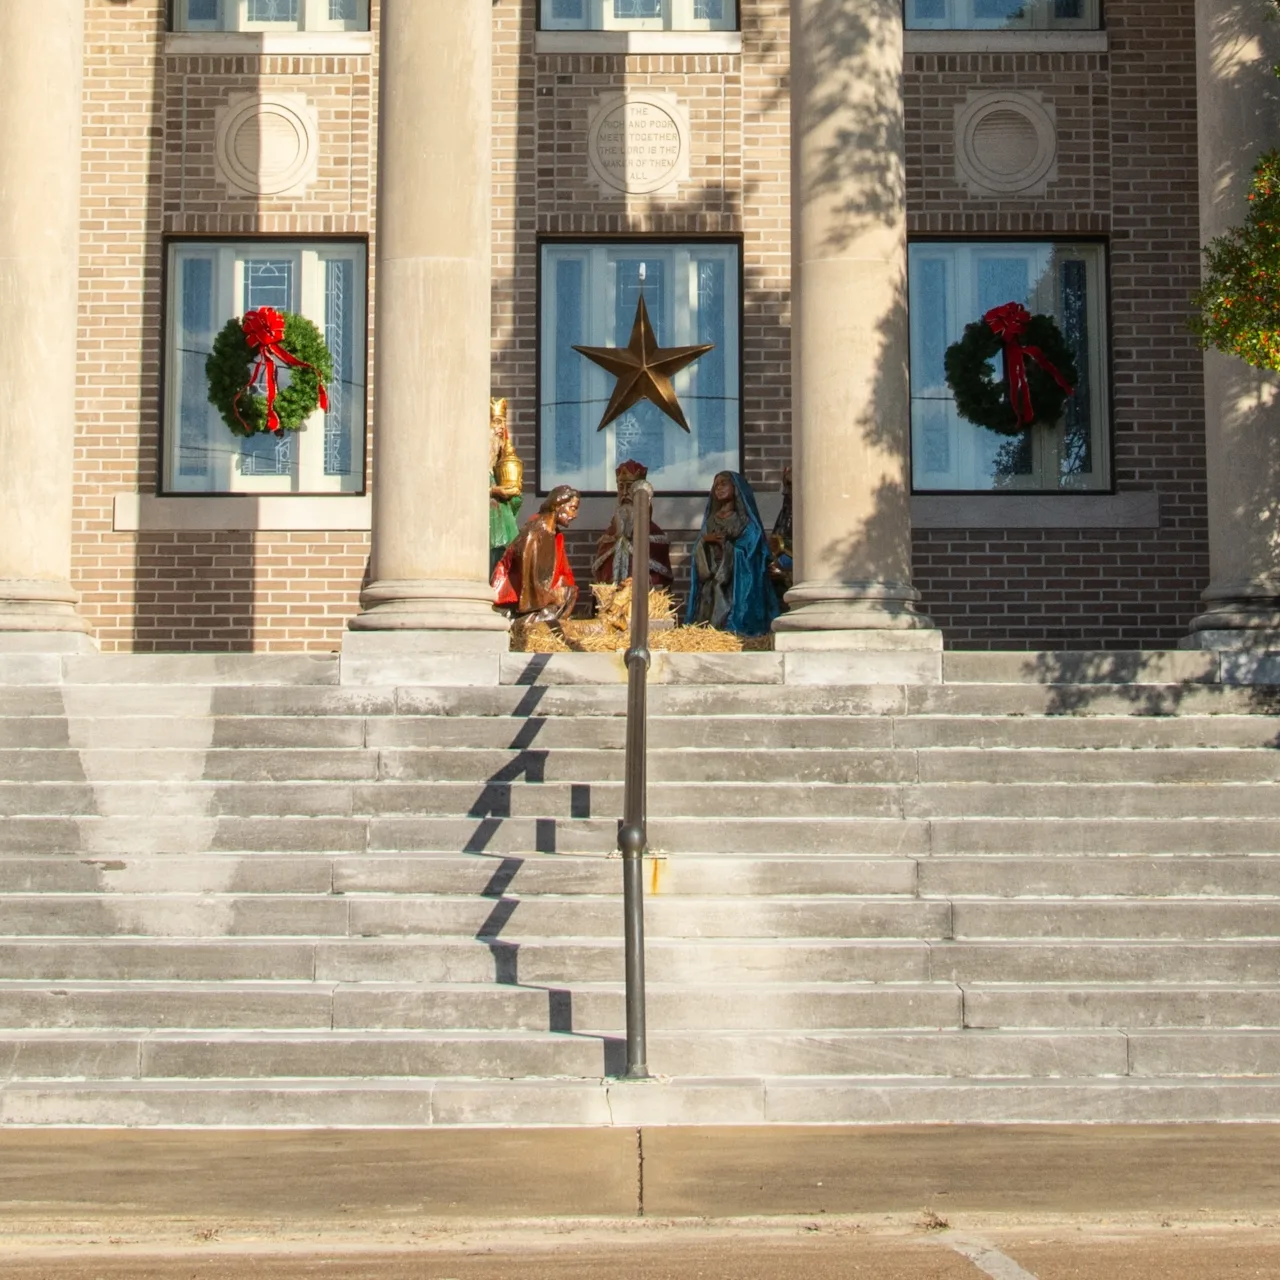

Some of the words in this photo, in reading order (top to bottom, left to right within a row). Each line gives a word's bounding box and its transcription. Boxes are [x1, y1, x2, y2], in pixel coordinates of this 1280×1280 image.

[630, 107, 649, 116] THE
[604, 120, 625, 129] RICH
[628, 120, 647, 129] AND
[649, 120, 674, 129] POOR
[600, 133, 625, 142] MEET
[629, 132, 678, 141] TOGETHER
[600, 146, 617, 155] THE
[620, 146, 645, 154] LORD
[647, 146, 657, 154] IS
[659, 146, 677, 154] THE
[635, 159, 646, 167] OF
[650, 159, 674, 167] THEM
[629, 172, 648, 180] ALL
